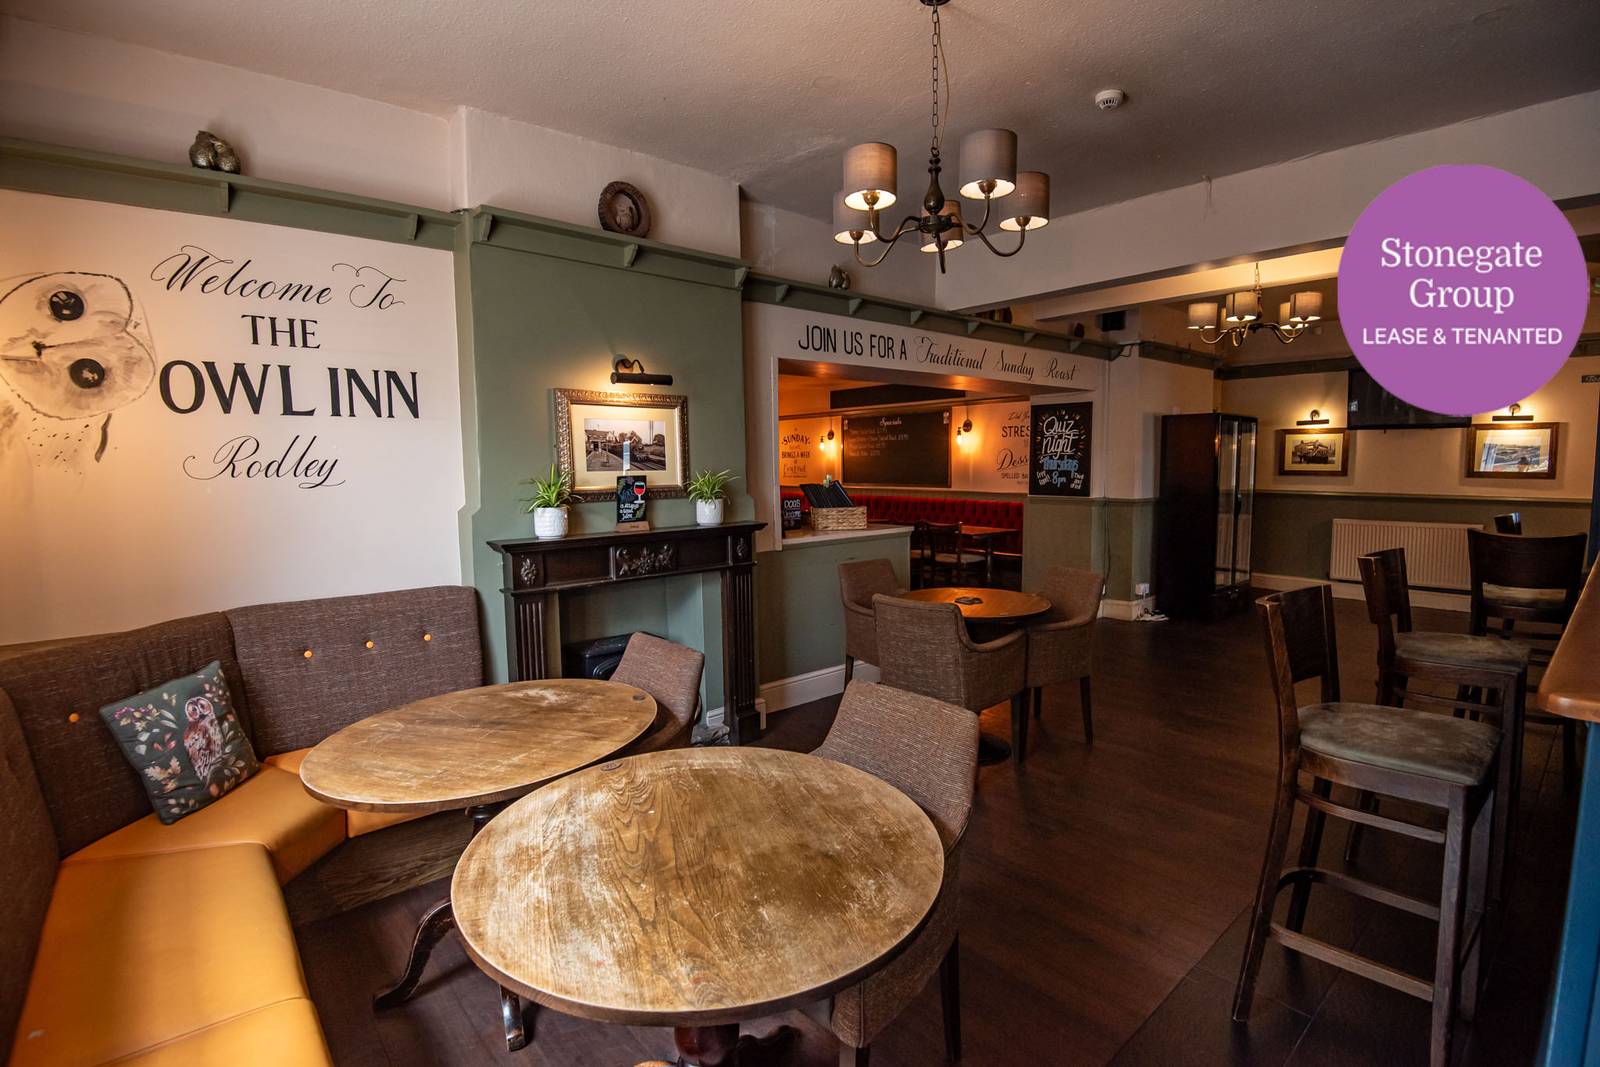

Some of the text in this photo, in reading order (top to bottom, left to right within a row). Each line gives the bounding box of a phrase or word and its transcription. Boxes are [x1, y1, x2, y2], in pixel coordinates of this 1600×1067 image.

[151, 245, 406, 310] Welcome To
[241, 314, 321, 349] THE
[798, 325, 1077, 381] JOIN US FOR A Traditional Sunday Roast
[159, 359, 420, 419] OWL INN
[1042, 433, 1076, 459] night
[1043, 415, 1079, 435] Quiz
[183, 435, 346, 490] Rodley
[1052, 470, 1067, 488] 8pm
